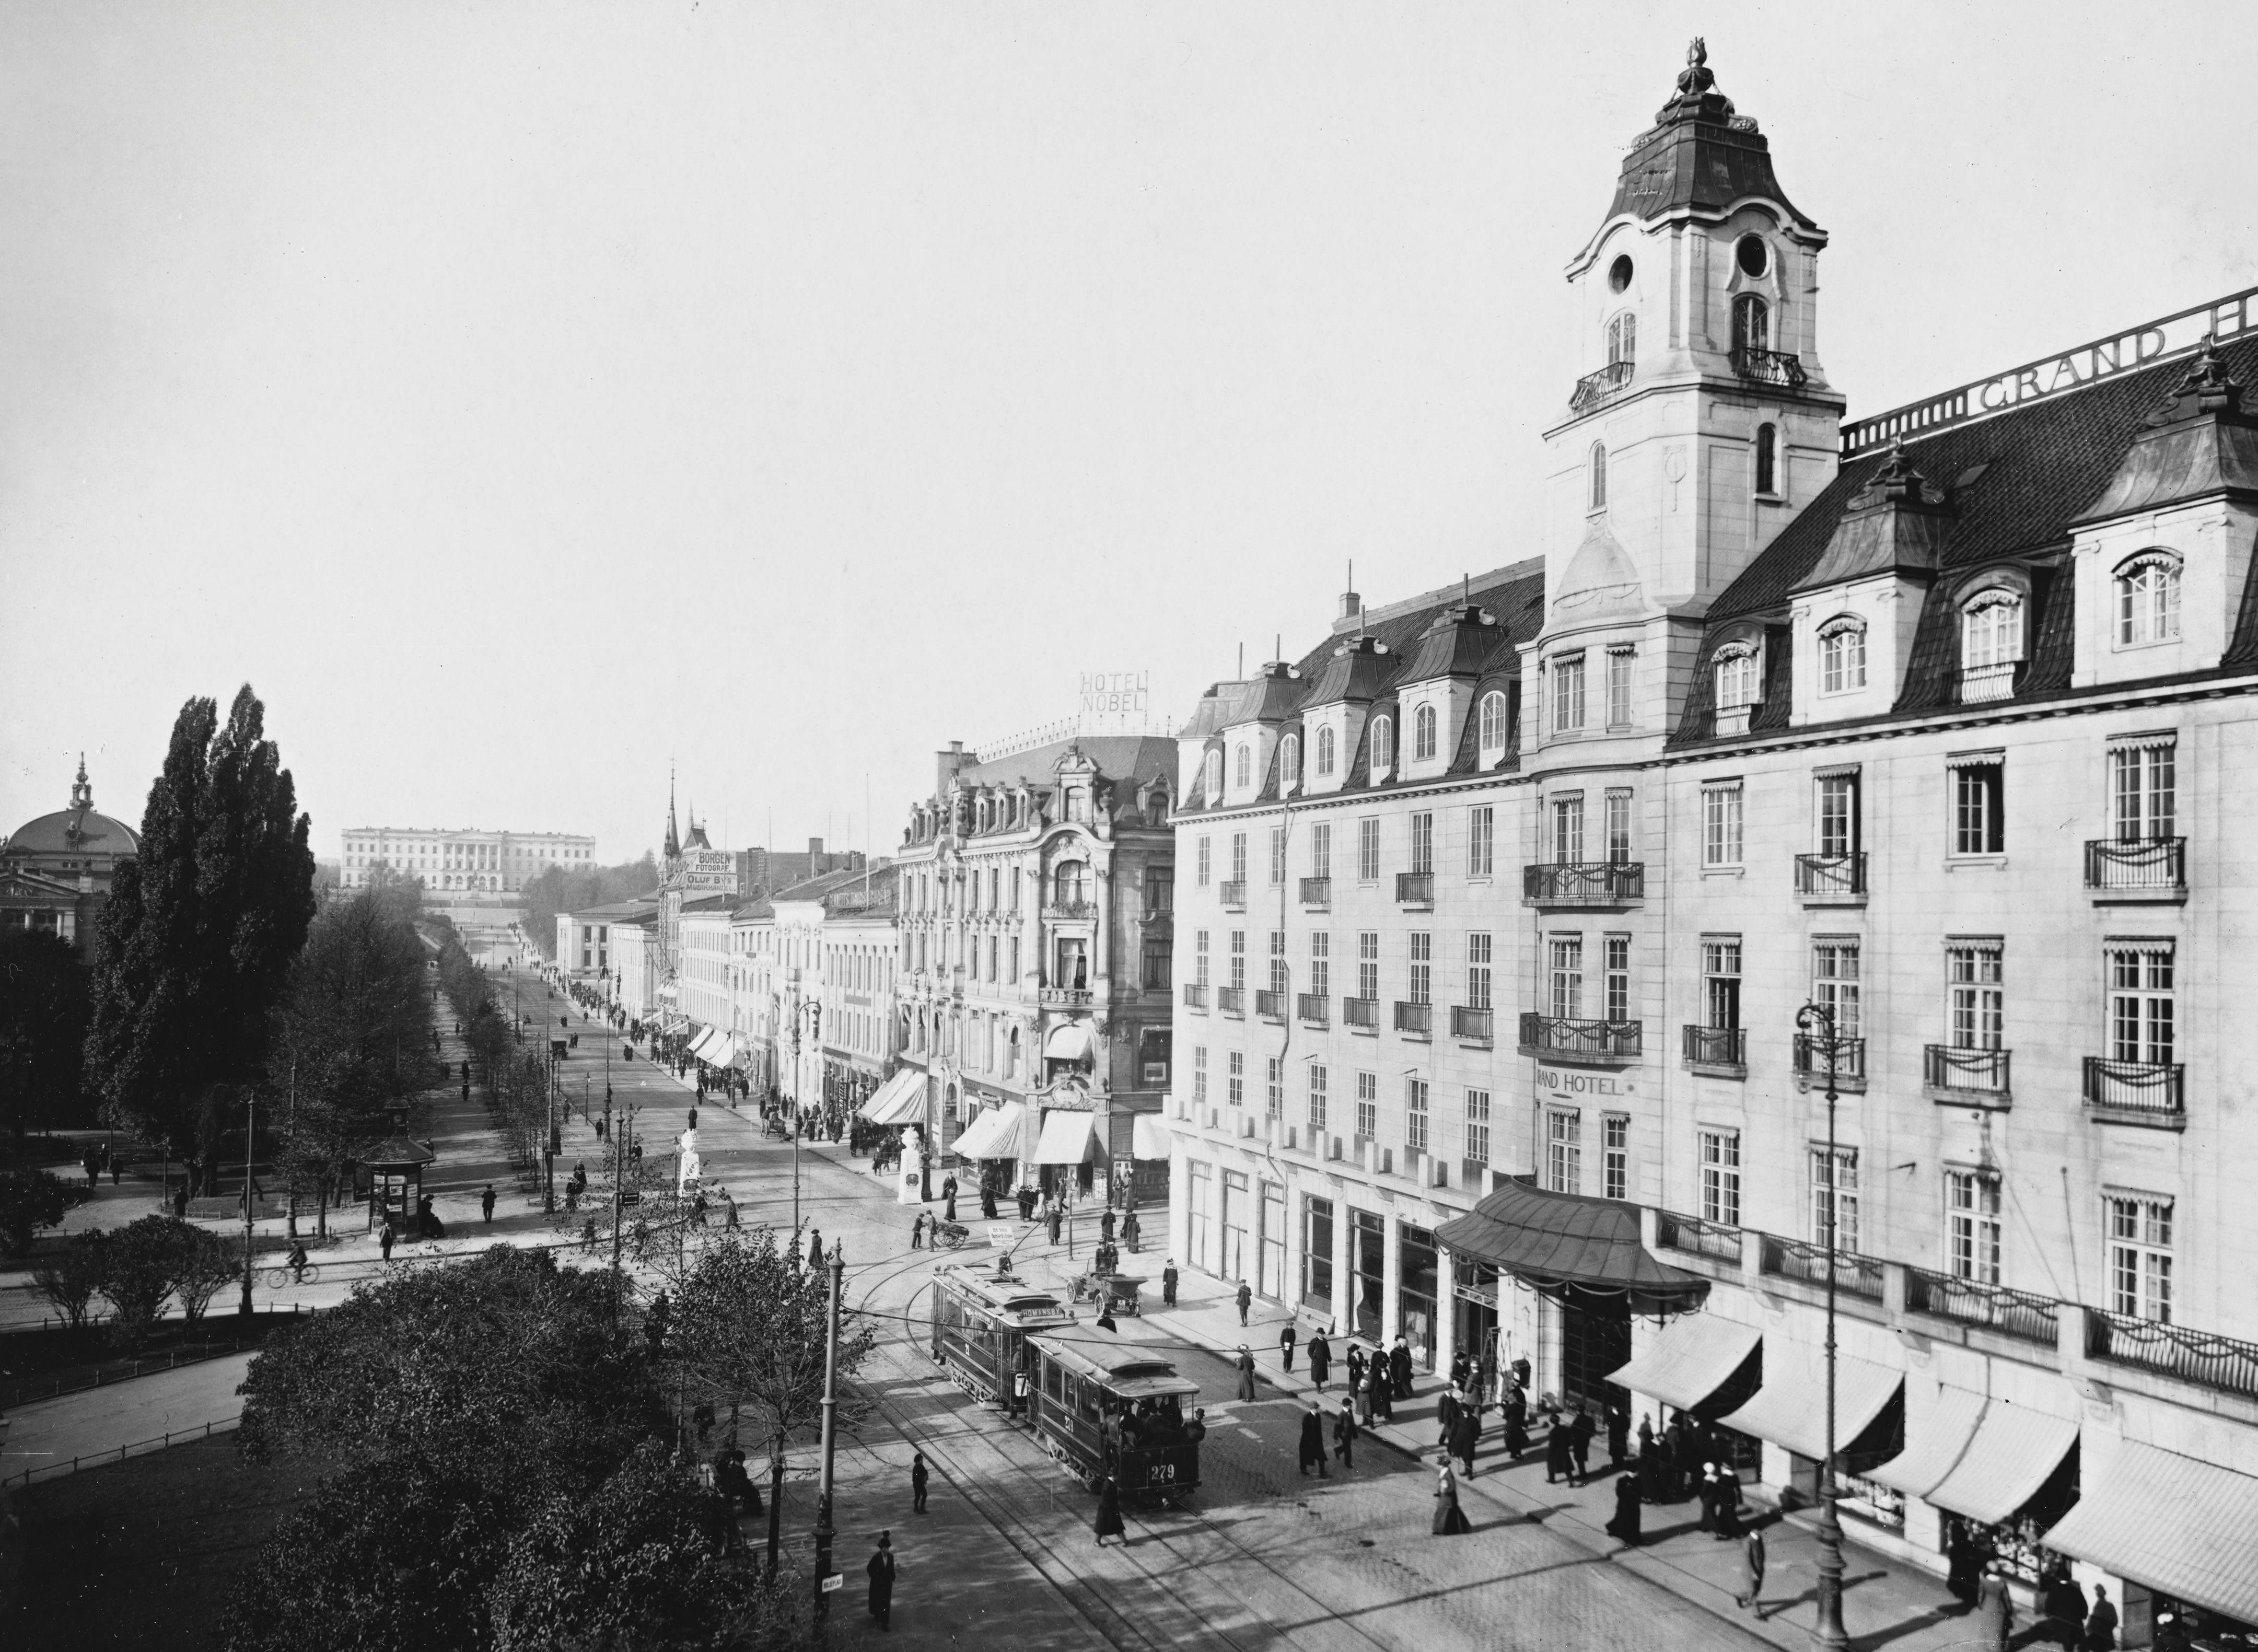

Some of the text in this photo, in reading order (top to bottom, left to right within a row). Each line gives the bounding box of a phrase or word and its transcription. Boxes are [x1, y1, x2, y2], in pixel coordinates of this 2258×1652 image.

[1980, 326, 2165, 411] GRAND
[1081, 673, 1146, 691] HOTEL
[1083, 693, 1143, 712] NOBEL
[699, 853, 730, 864] BORGEN
[1564, 1074, 1624, 1096] HOTEL
[965, 1343, 970, 1356] 21
[1065, 1415, 1074, 1433] 279
[1151, 1464, 1175, 1483] 279
